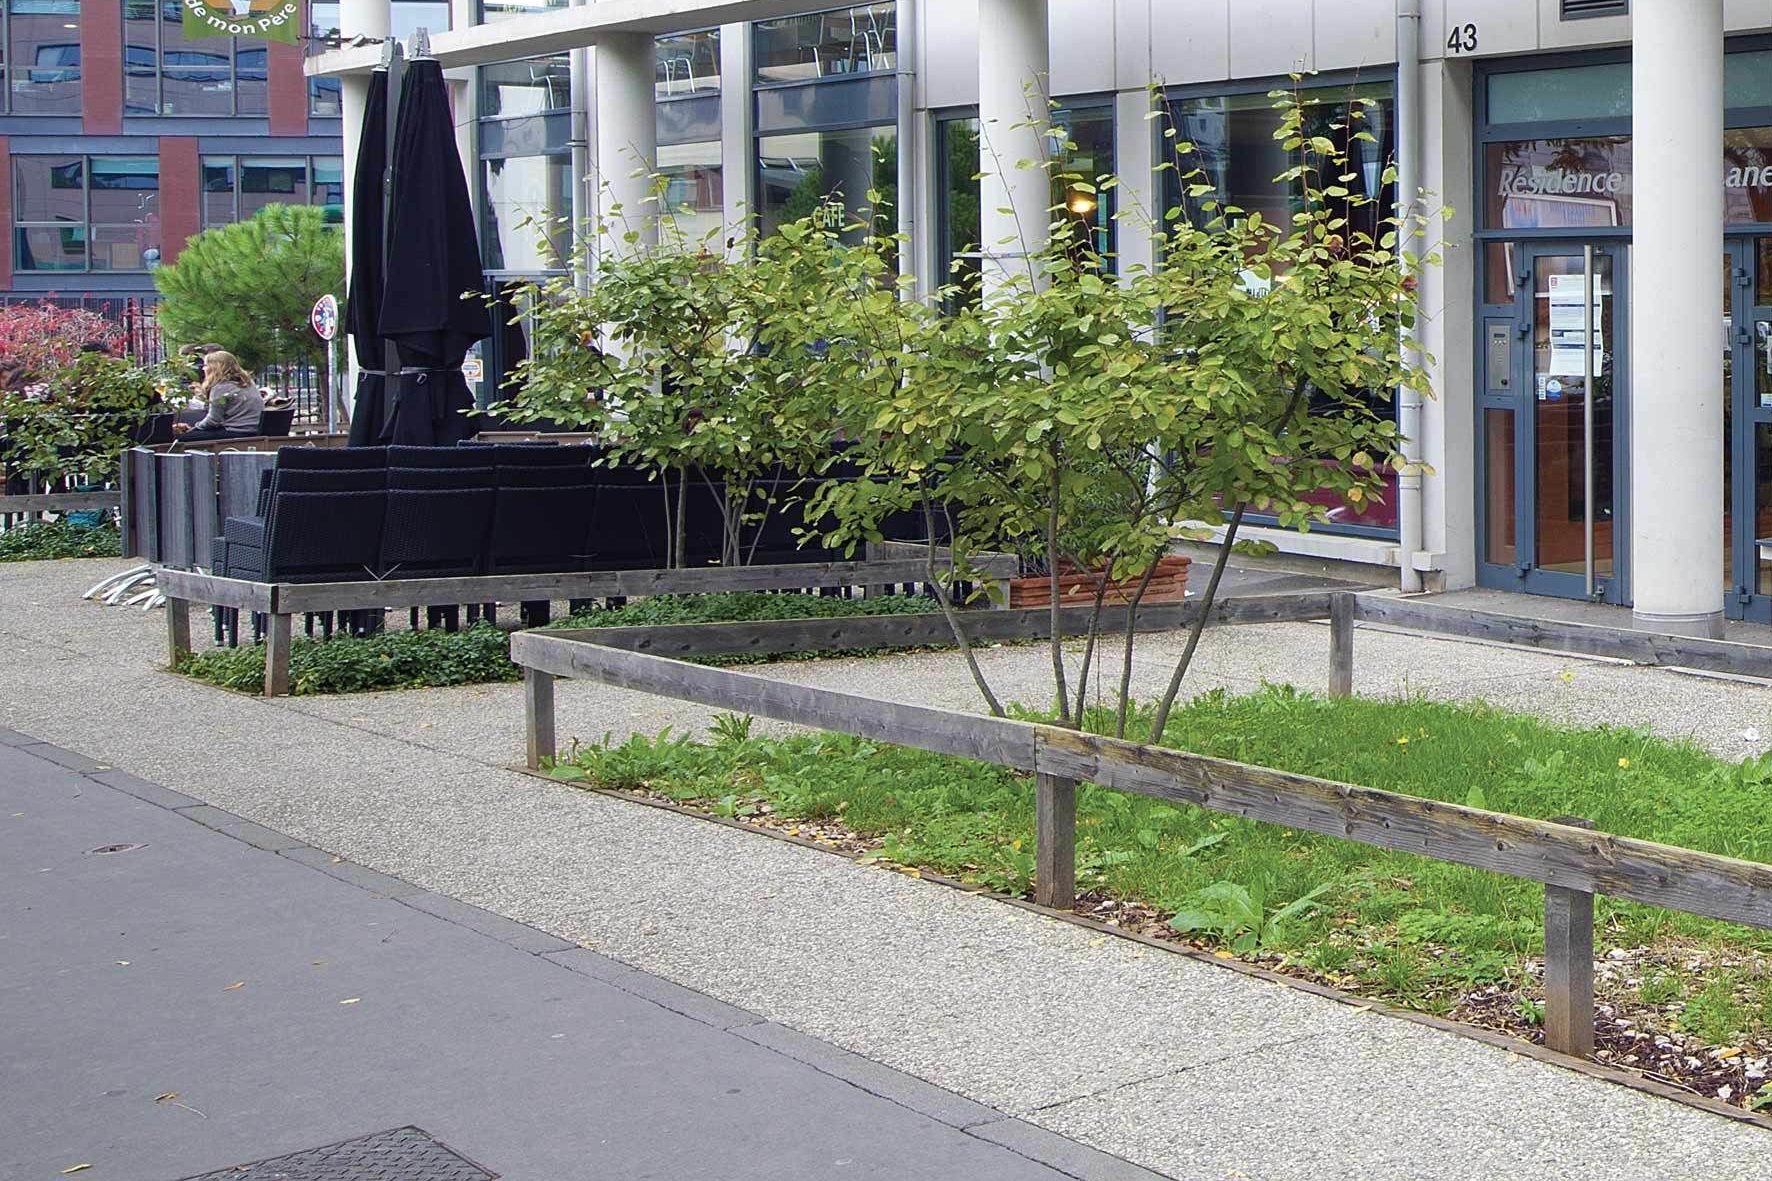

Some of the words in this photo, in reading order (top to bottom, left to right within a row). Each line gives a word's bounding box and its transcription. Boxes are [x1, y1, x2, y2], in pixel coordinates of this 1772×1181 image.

[207, 18, 256, 35] mon
[257, 1, 297, 32] Père
[1447, 23, 1479, 54] 43
[1498, 167, 1622, 196] Résidence
